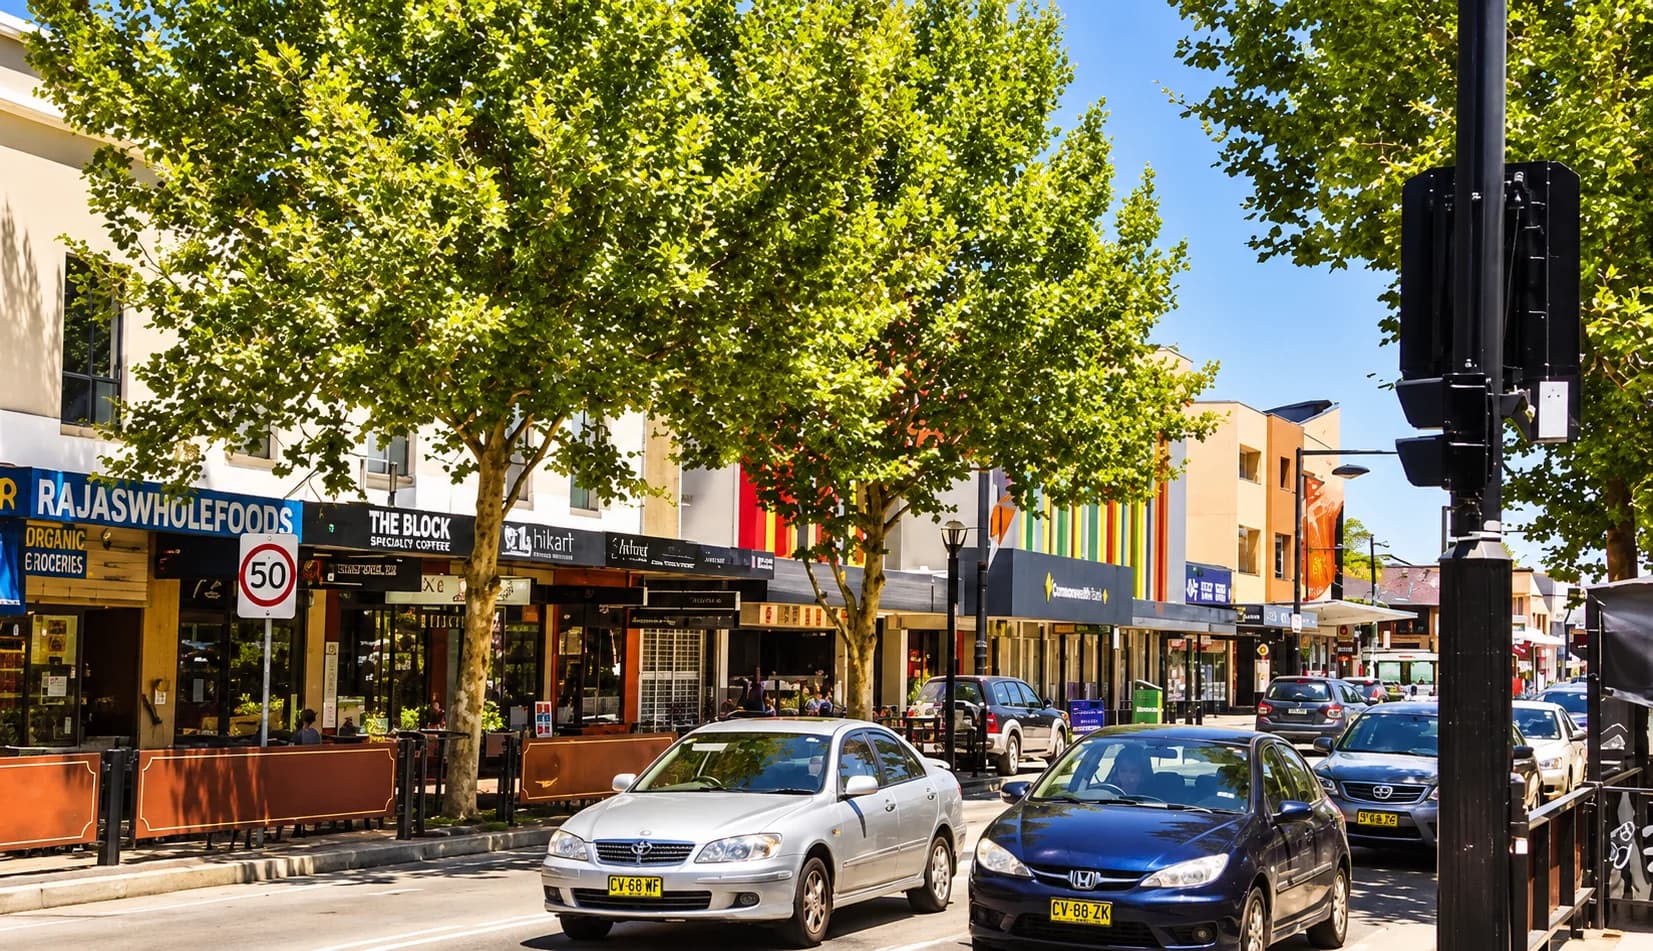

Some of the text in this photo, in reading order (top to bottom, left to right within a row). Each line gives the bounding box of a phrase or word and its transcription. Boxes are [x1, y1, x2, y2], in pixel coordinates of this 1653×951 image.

[369, 510, 451, 539] THE BLOCK
[533, 528, 575, 552] hikart
[250, 561, 286, 589] 50
